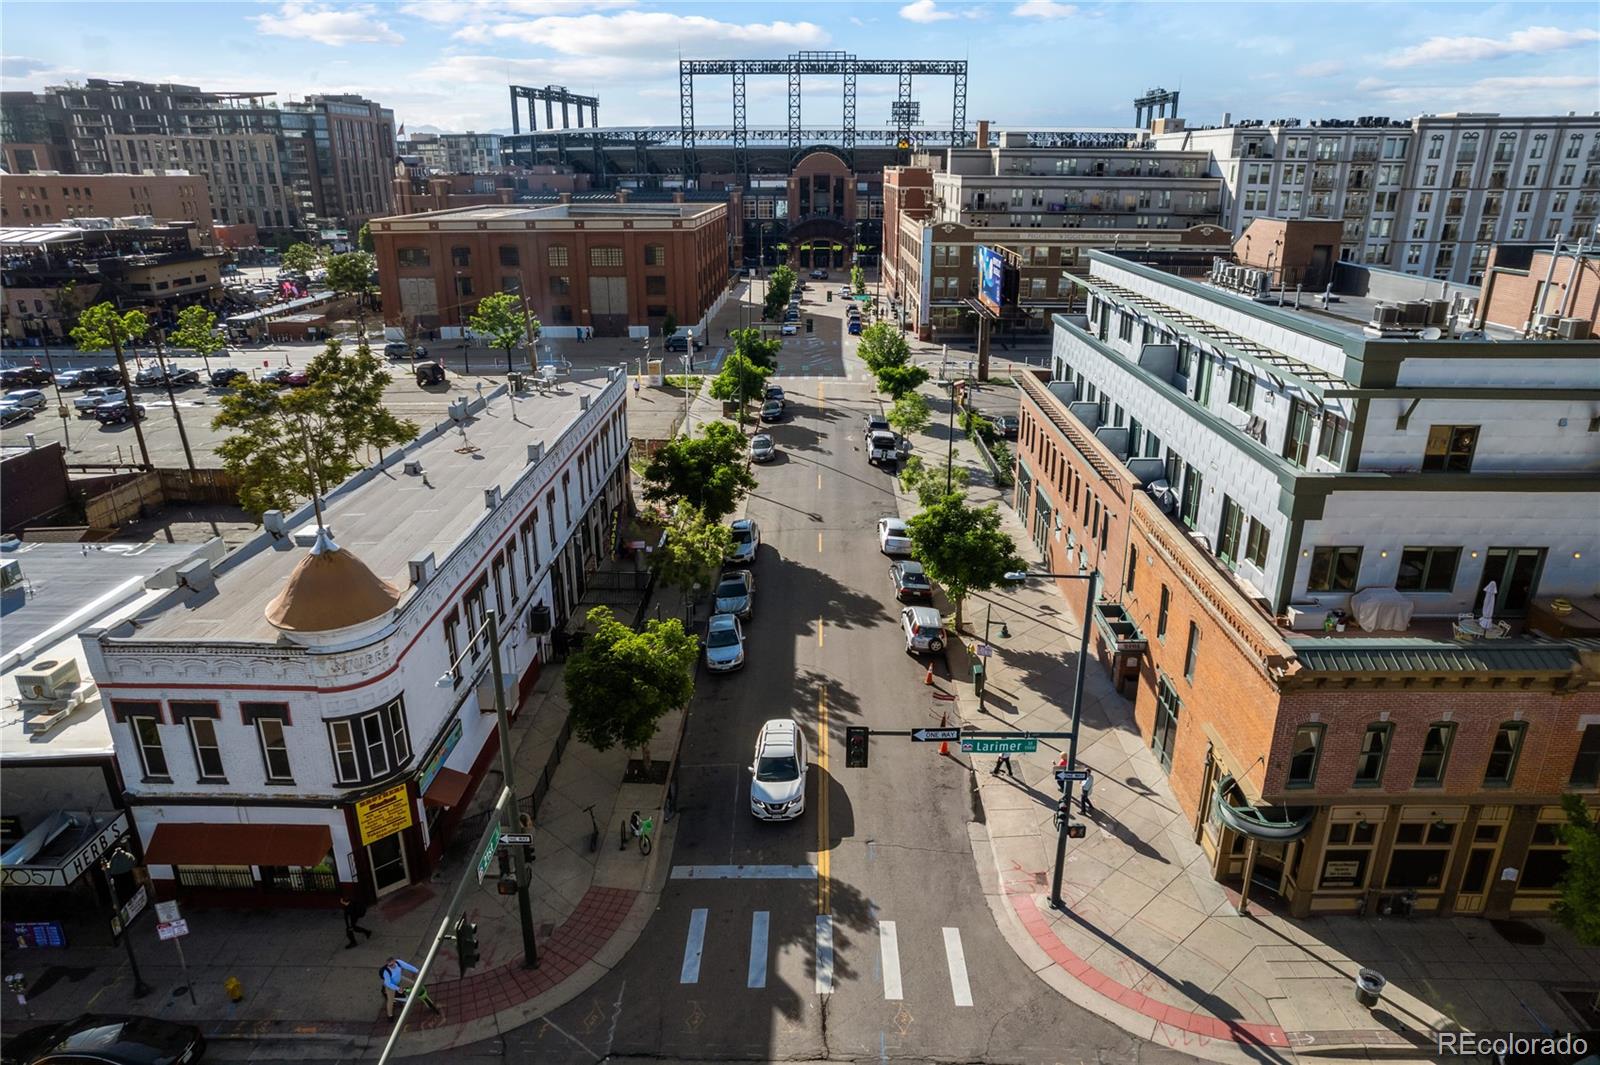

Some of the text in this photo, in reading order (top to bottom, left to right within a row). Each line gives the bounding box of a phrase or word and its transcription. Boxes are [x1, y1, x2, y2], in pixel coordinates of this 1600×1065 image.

[976, 741, 1022, 751] Larimer
[73, 823, 121, 875] HERB'S
[1, 868, 55, 885] 2057
